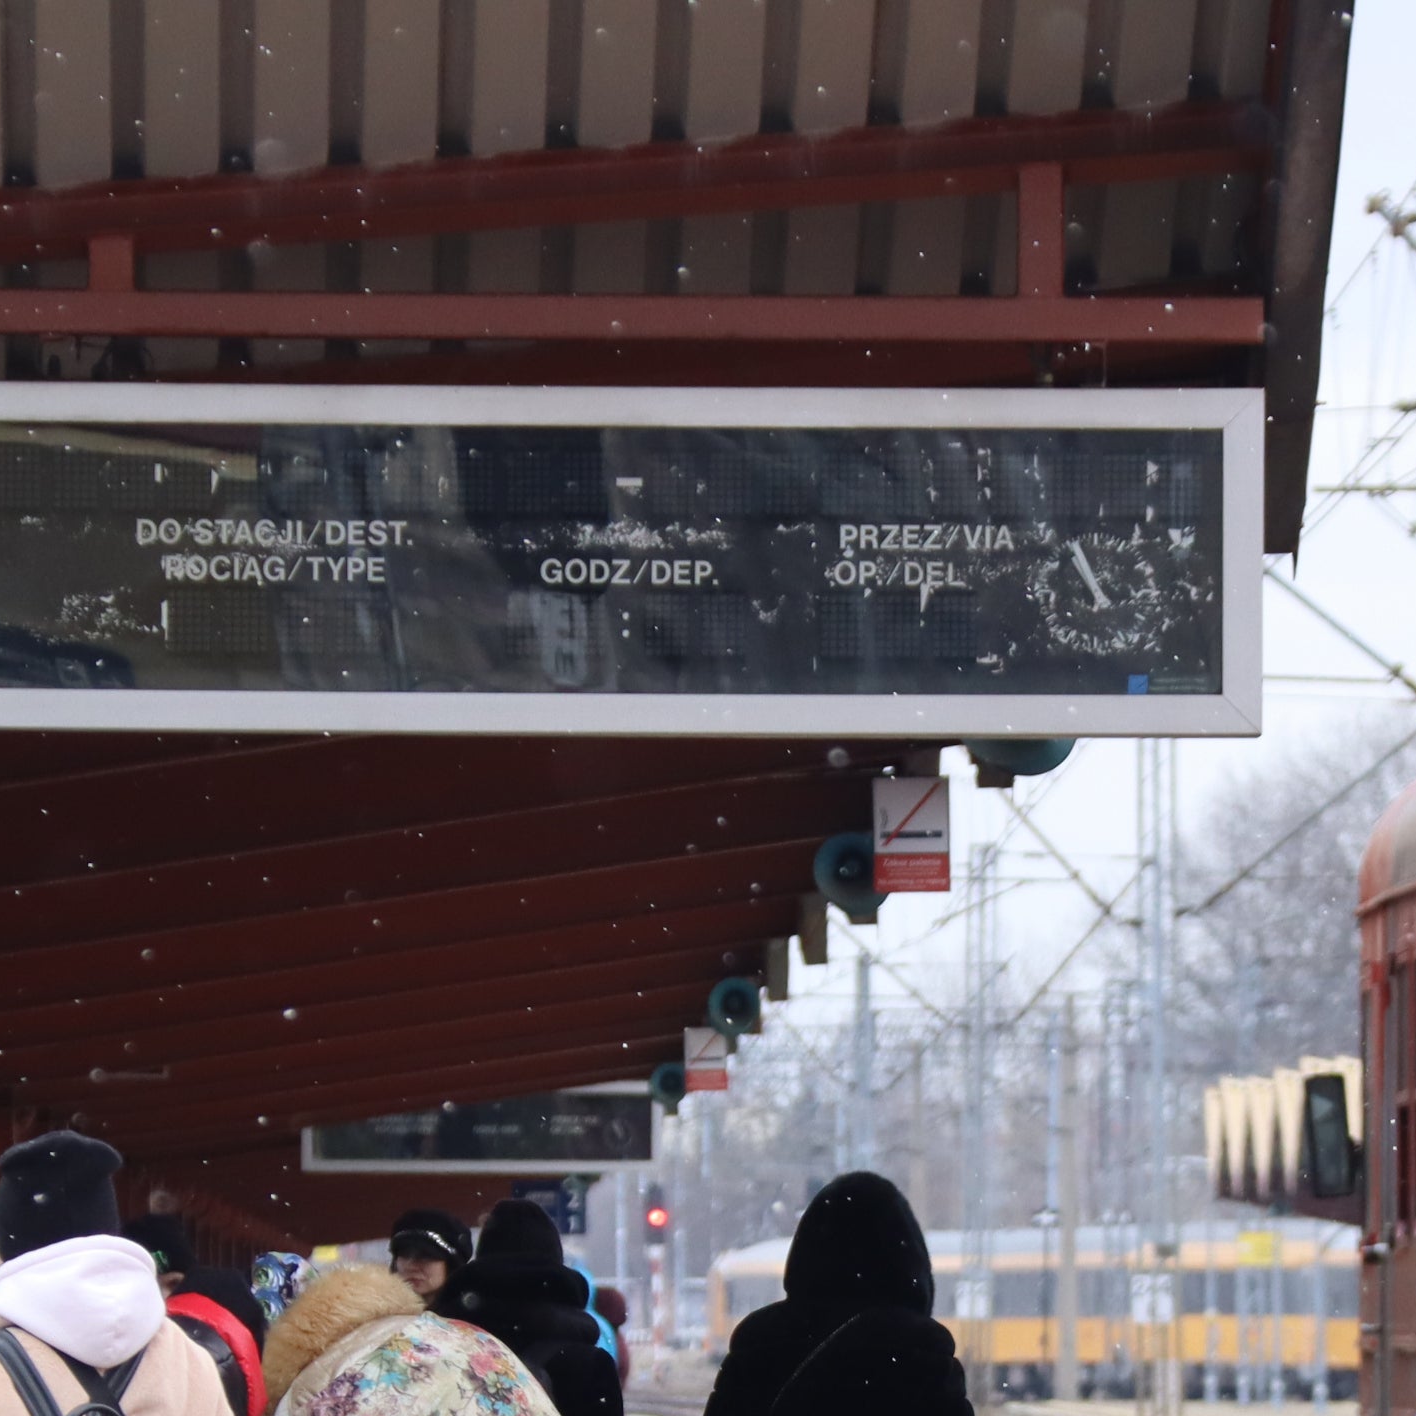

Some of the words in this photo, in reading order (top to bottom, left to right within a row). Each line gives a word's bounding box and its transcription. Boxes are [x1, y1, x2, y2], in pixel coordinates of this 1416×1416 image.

[136, 518, 181, 545] DO
[194, 518, 413, 546] STACJI/DEST.
[839, 524, 1015, 550] PRZEZ/VIA
[540, 558, 719, 586] GODZ/DEP.
